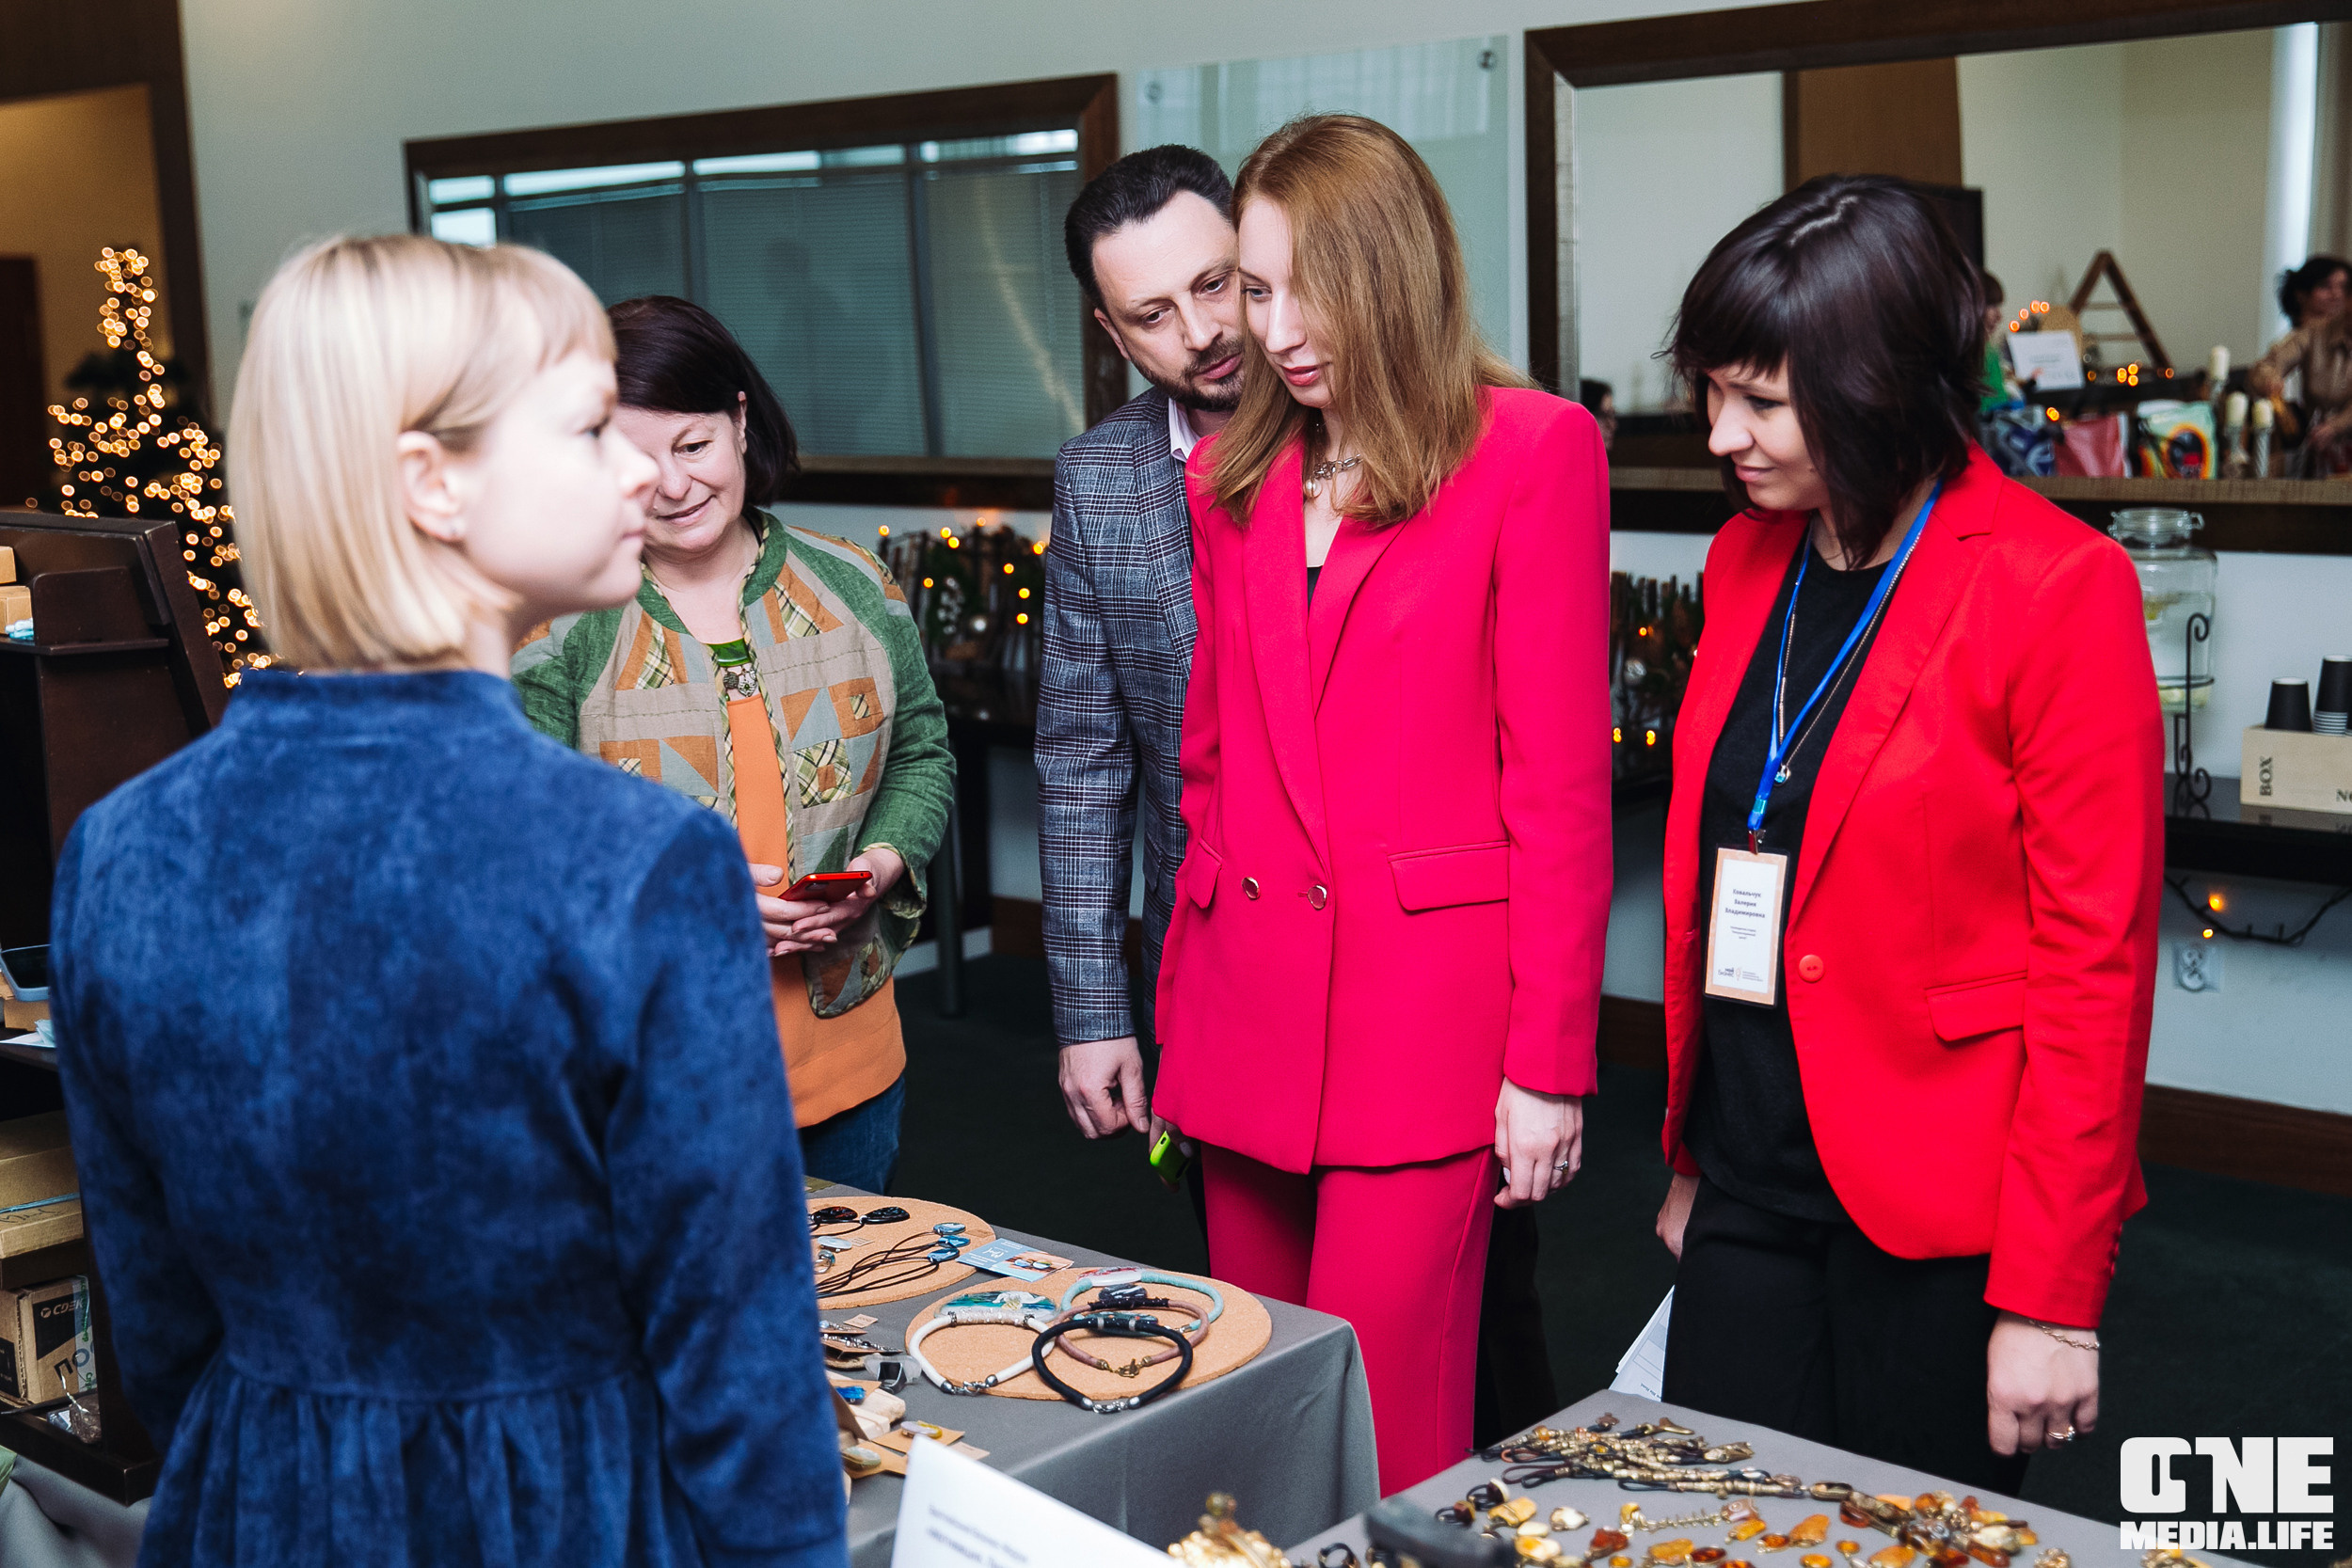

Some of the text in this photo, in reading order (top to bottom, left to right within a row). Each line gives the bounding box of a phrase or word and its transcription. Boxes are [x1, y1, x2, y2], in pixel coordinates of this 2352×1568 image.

[2259, 756, 2273, 796] BOX
[1733, 889, 1762, 898] Ковальчук
[1734, 898, 1756, 908] Валерия
[1724, 908, 1766, 918] Владимировна
[53, 1299, 84, 1316] CDEK
